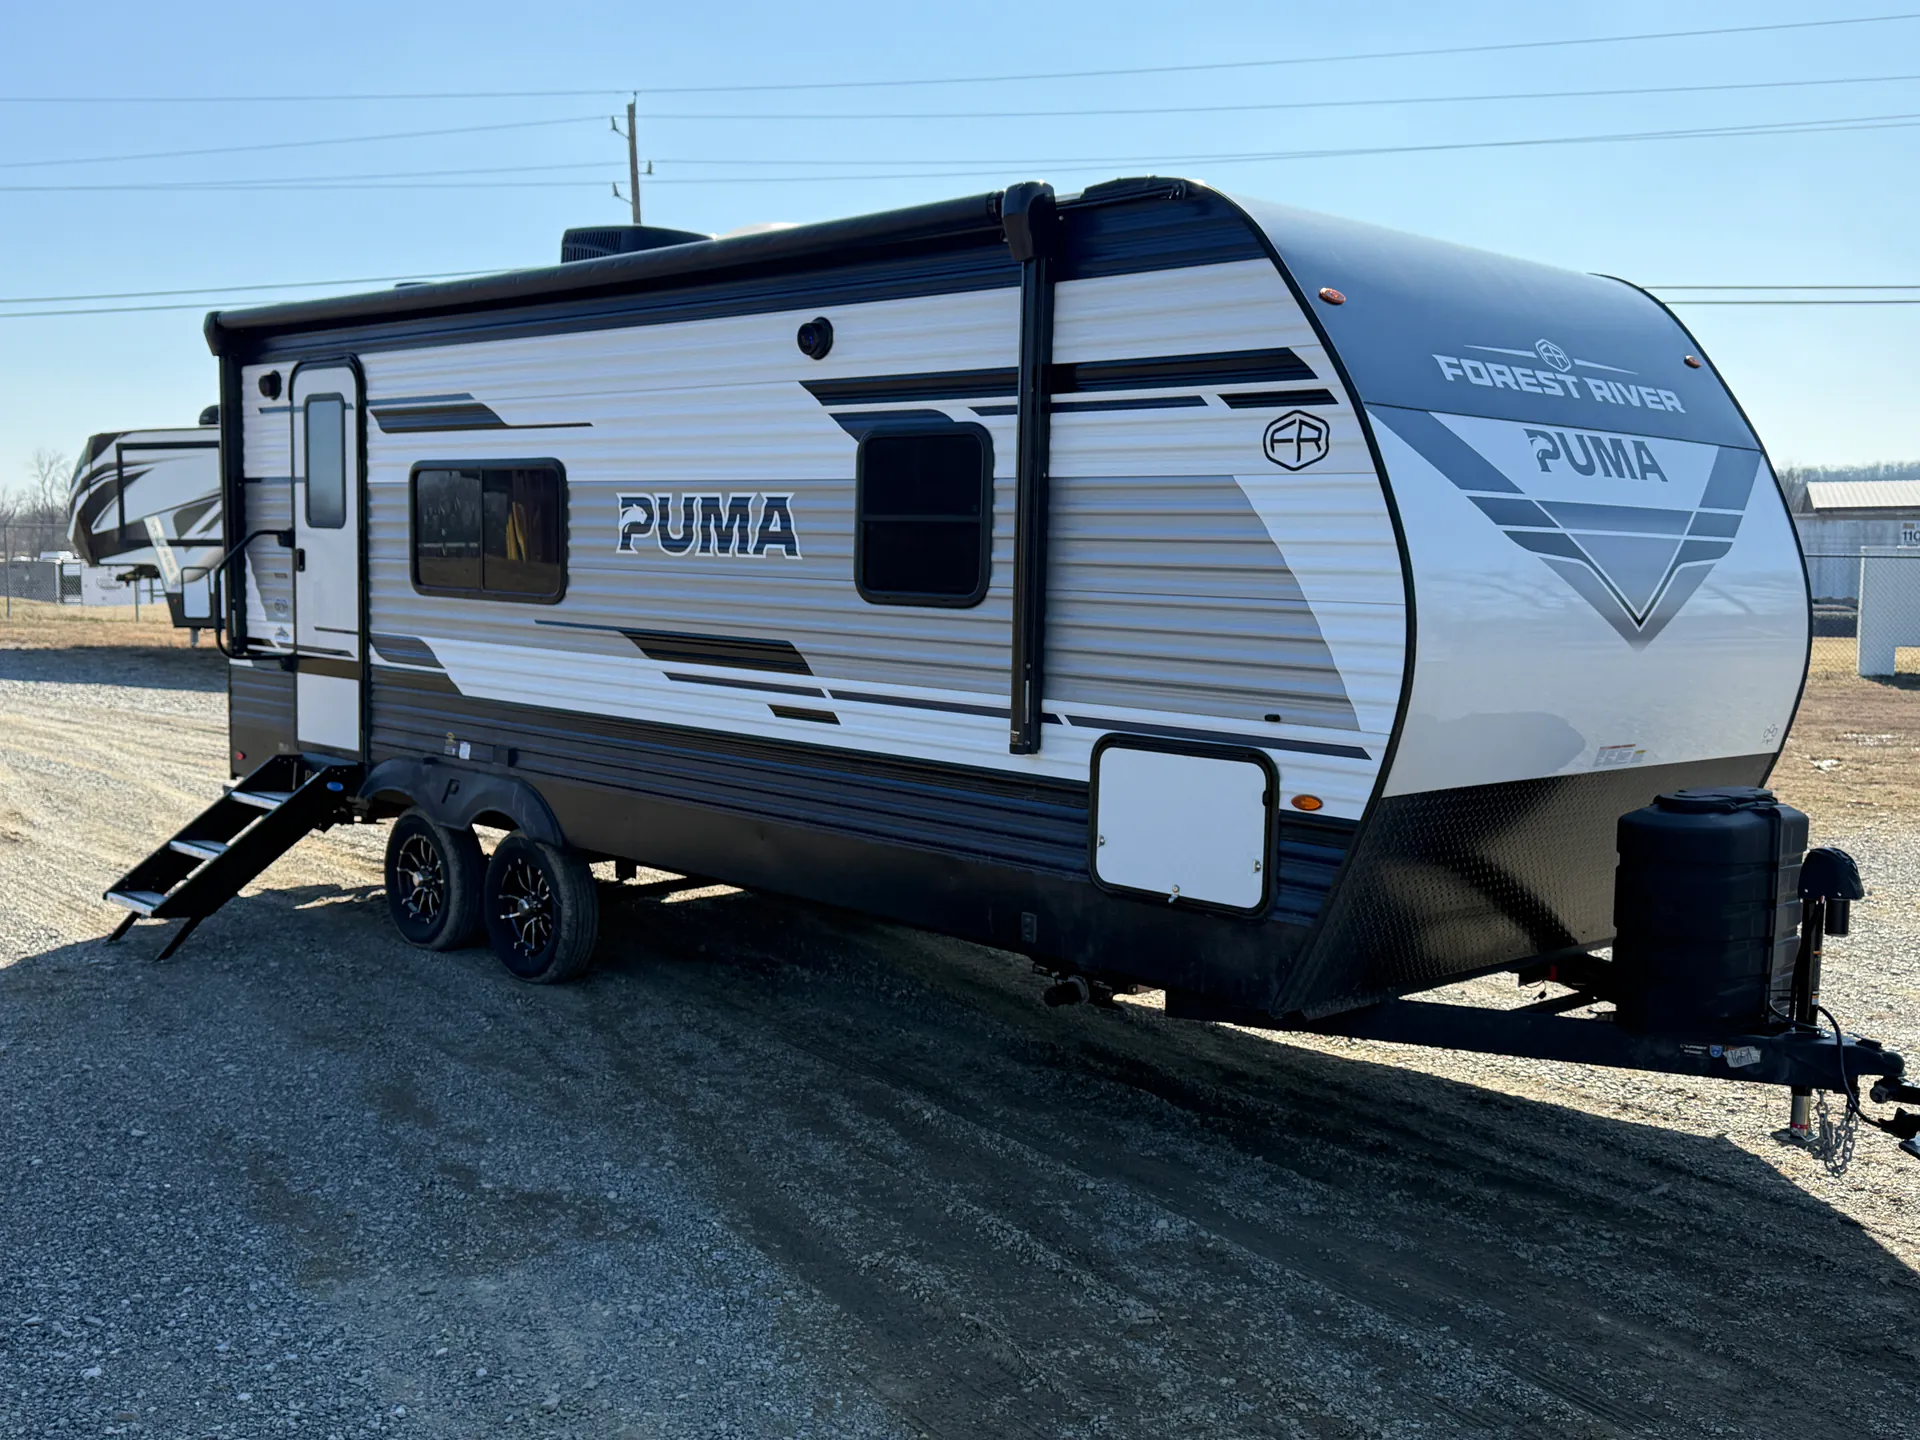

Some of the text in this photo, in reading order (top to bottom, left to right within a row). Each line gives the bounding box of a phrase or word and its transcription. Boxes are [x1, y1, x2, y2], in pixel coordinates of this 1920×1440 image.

[1432, 354, 1687, 414] FOREST RIVER
[1522, 428, 1669, 483] PUMA
[615, 492, 803, 560] PUMA
